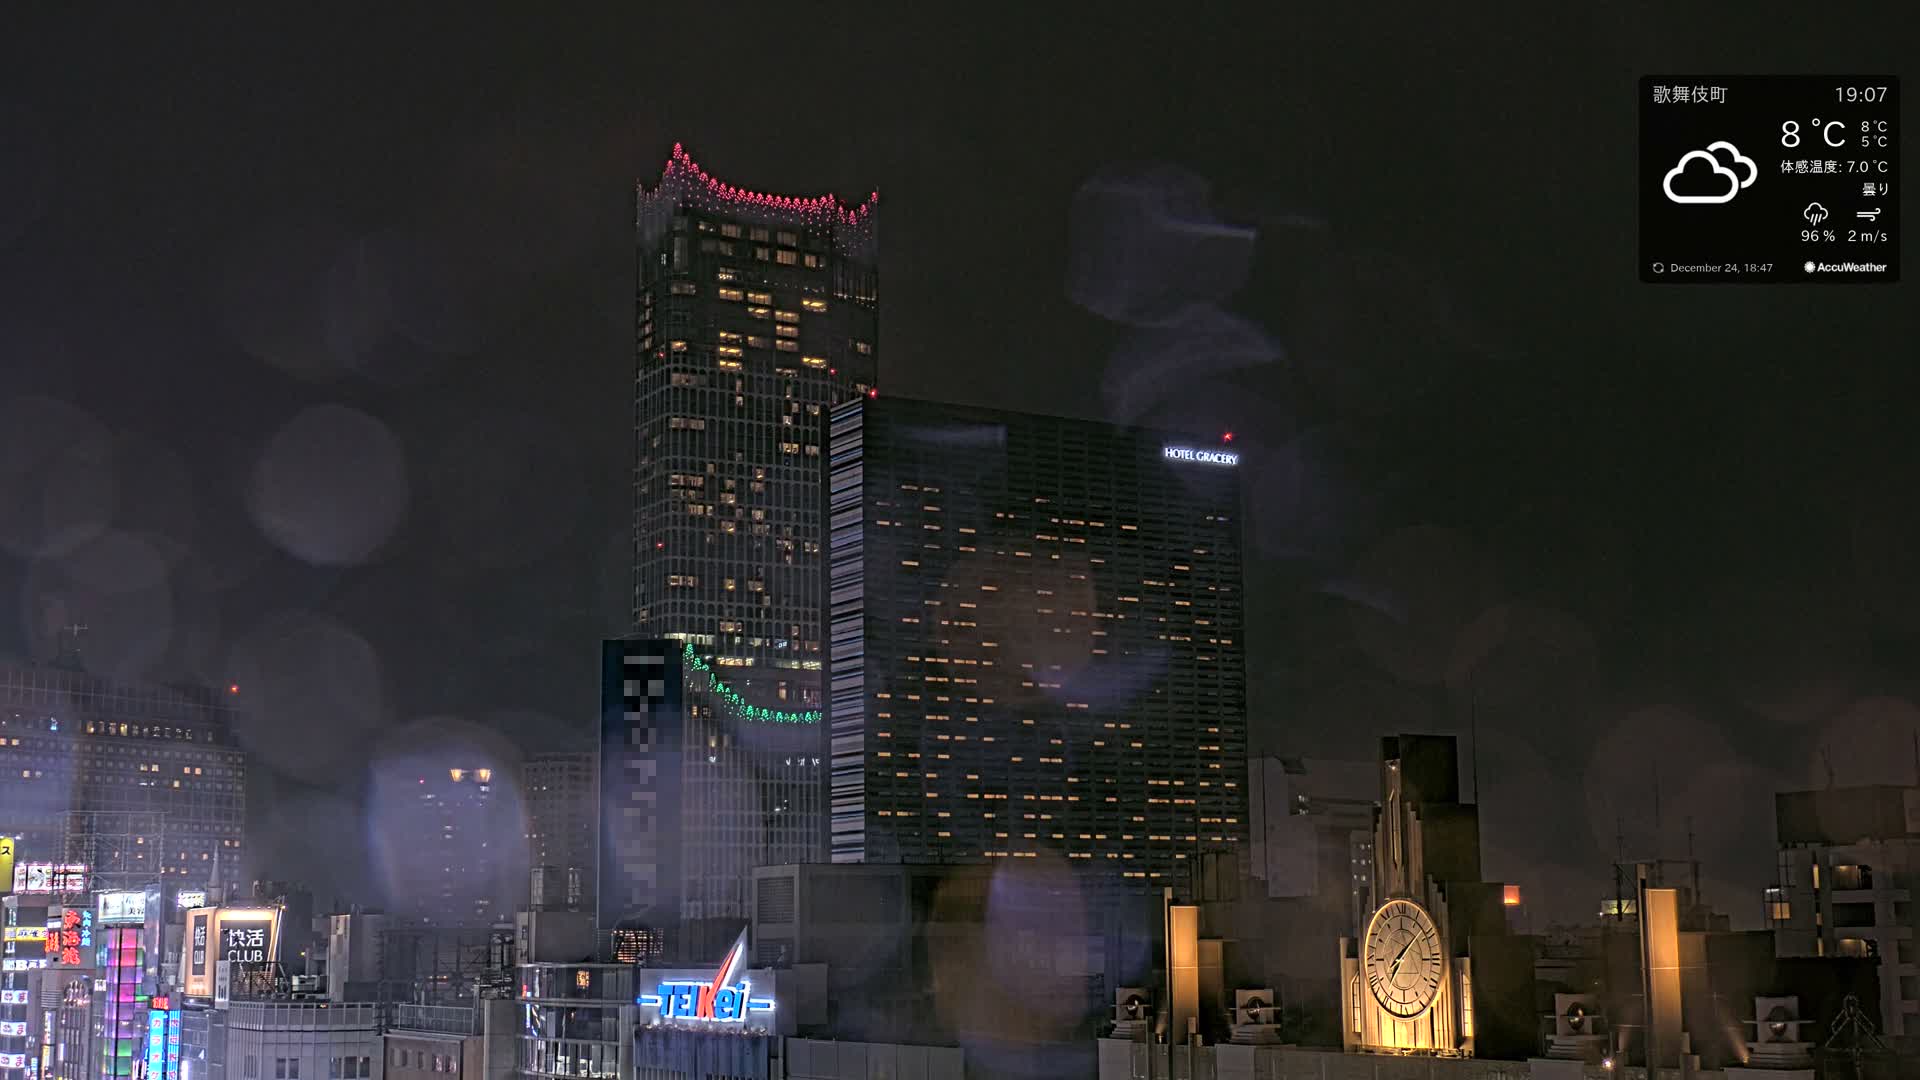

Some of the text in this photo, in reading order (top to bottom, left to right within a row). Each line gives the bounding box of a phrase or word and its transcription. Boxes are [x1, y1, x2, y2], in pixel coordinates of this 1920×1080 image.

[1165, 447, 1238, 465] HOTEL GRACERY
[229, 928, 264, 947] 快活
[228, 949, 263, 963] CLUB
